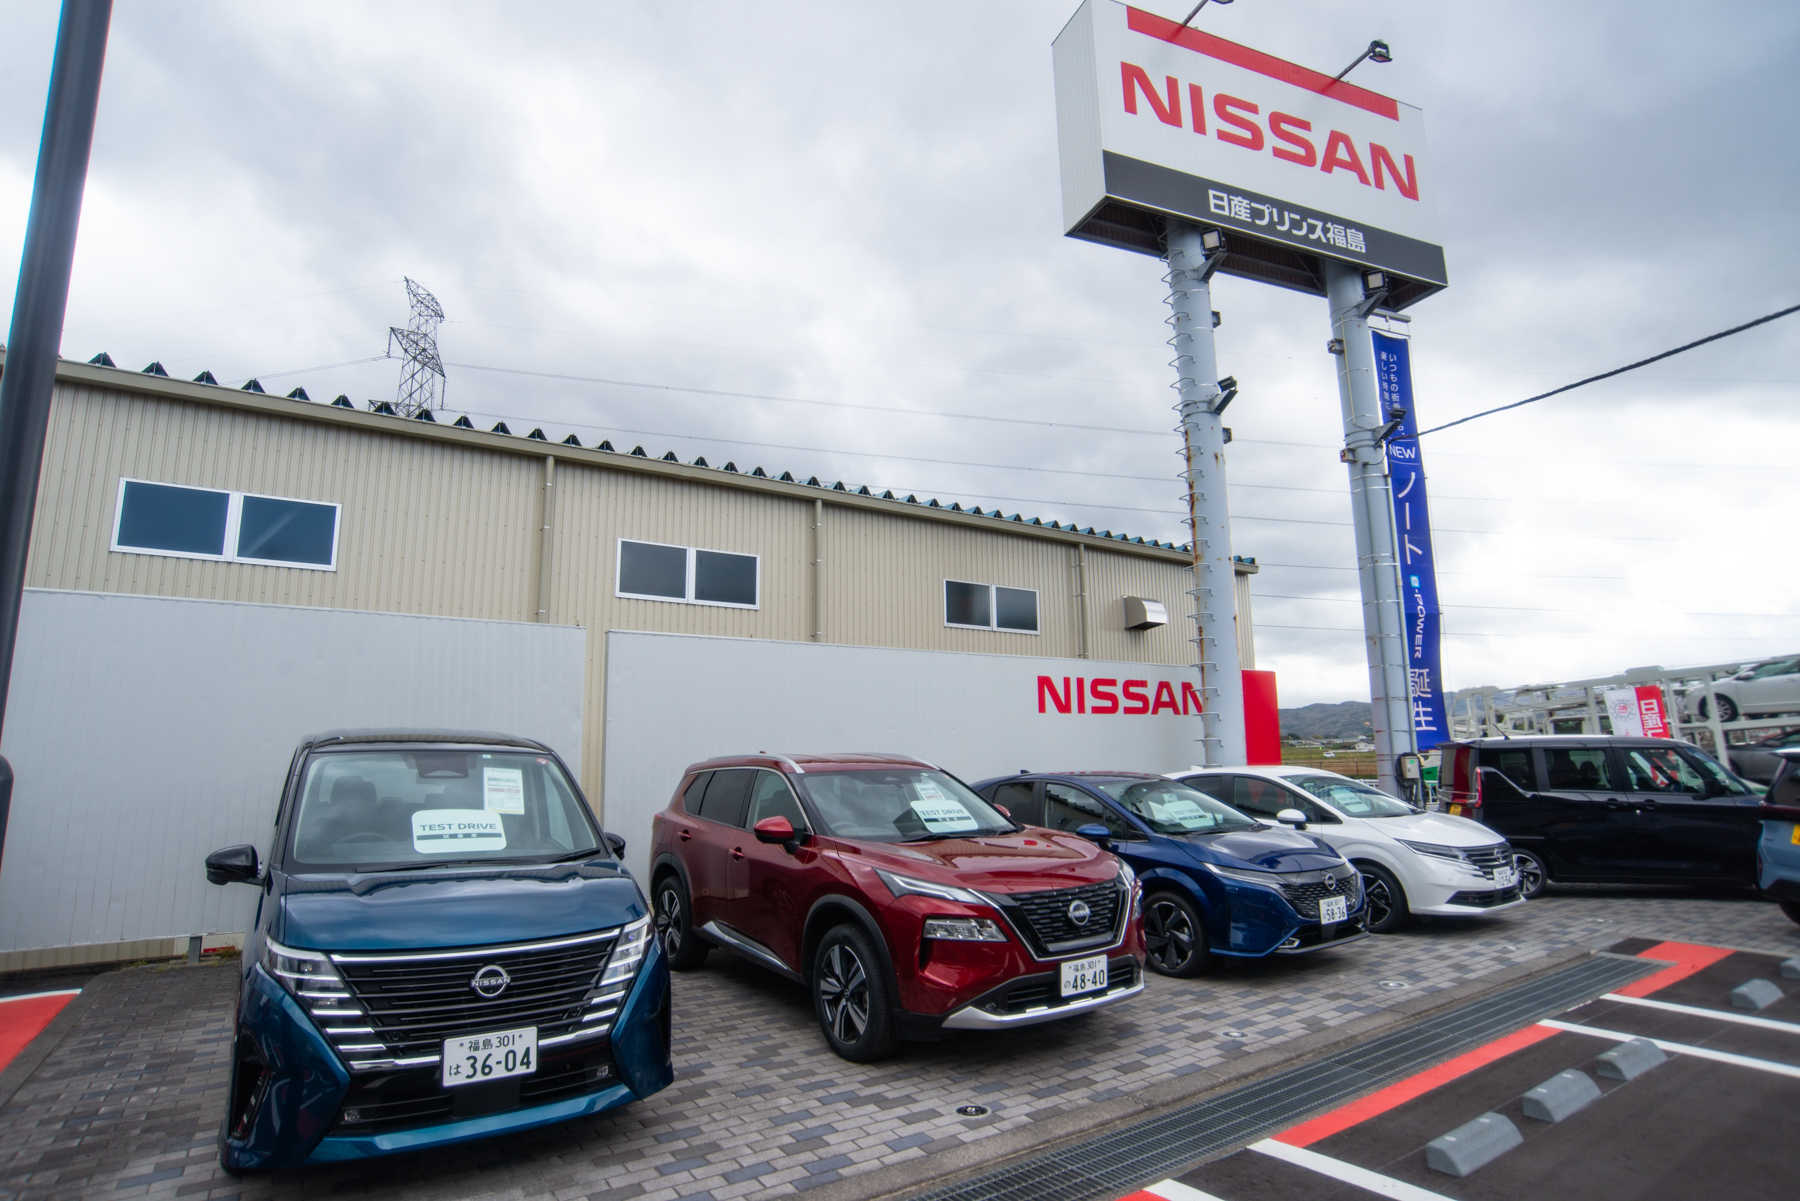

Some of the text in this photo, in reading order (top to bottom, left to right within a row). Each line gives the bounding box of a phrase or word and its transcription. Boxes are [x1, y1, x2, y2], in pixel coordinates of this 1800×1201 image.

[1120, 61, 1420, 202] NISSAN
[1208, 189, 1366, 254] 日産プリンス福島
[1389, 446, 1416, 459] NEW
[1398, 471, 1423, 565] ノート
[1409, 574, 1426, 660] e-POWER
[1037, 675, 1203, 716] NISSAN
[1410, 668, 1438, 731] 誕生
[420, 823, 497, 832] TEST DRIVE
[920, 809, 941, 817] TEST
[472, 976, 511, 987] NISSAN
[1064, 969, 1105, 992] の 48-40
[468, 1033, 516, 1052] 福島 301
[448, 1046, 532, 1079] は 36-04
